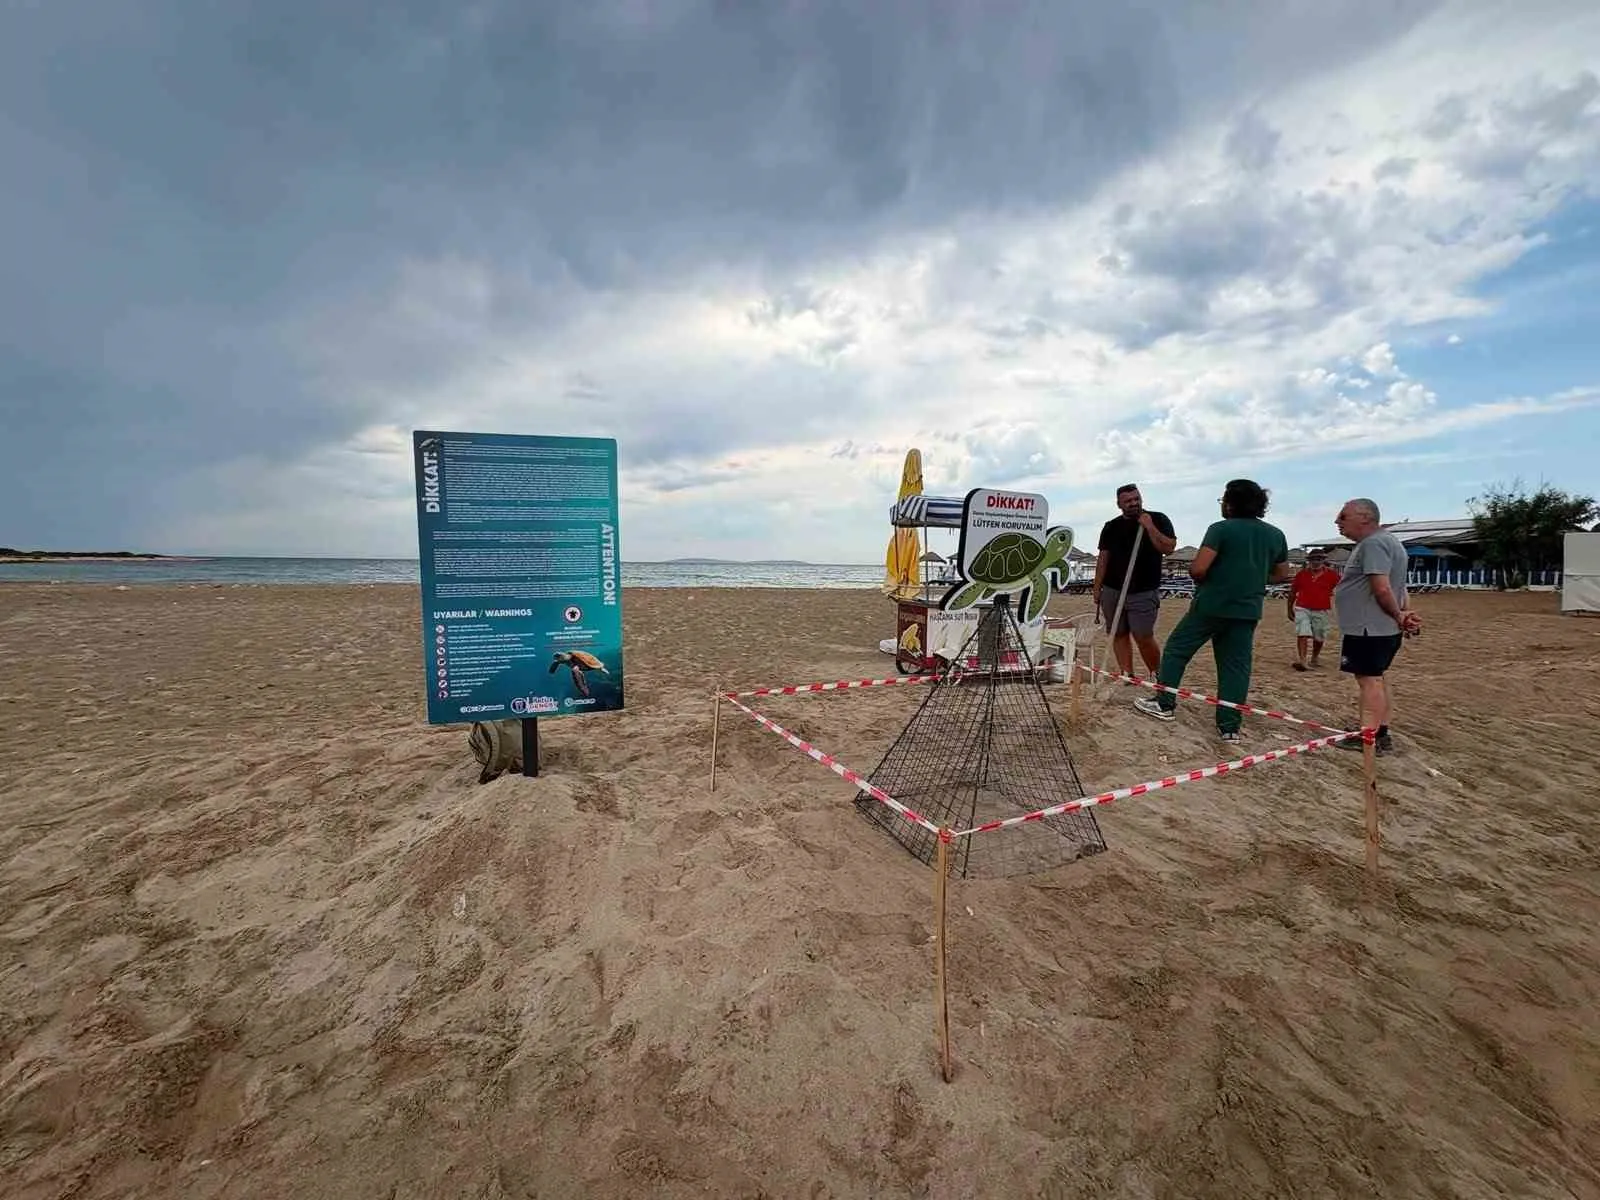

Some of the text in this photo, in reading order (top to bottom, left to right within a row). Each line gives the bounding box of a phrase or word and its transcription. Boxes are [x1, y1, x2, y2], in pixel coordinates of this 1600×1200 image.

[421, 451, 440, 512] DİKKAT!
[986, 493, 1034, 510] DİKKAT!
[972, 517, 1043, 531] LÜTFEN KORUYALIM
[601, 523, 616, 605] ATTENTION!
[433, 609, 477, 619] UYARILAR
[484, 608, 533, 617] WARNINGS
